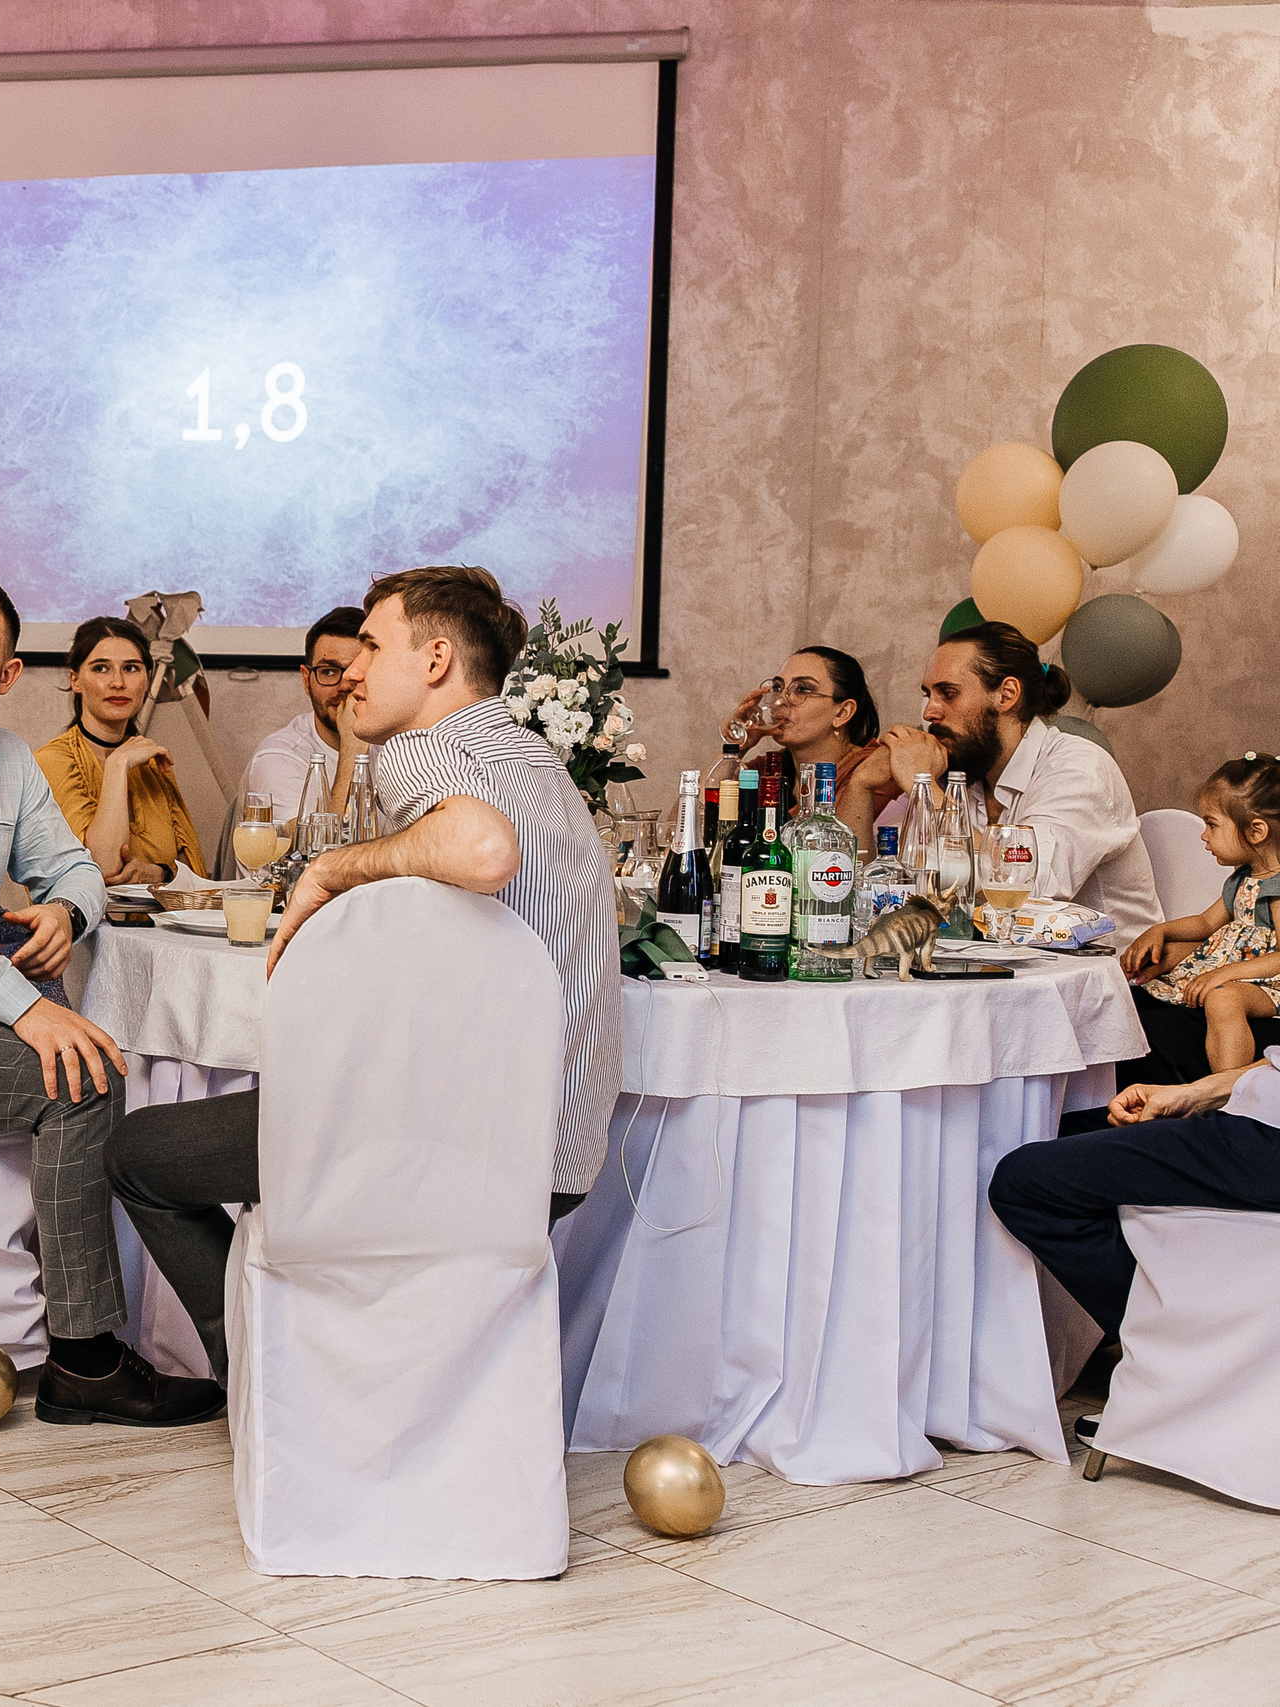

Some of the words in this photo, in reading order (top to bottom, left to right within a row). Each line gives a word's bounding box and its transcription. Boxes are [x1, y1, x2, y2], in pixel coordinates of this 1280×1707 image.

[182, 361, 309, 451] 1,8
[745, 875, 791, 889] JAMESON
[813, 871, 852, 881] MARTINI
